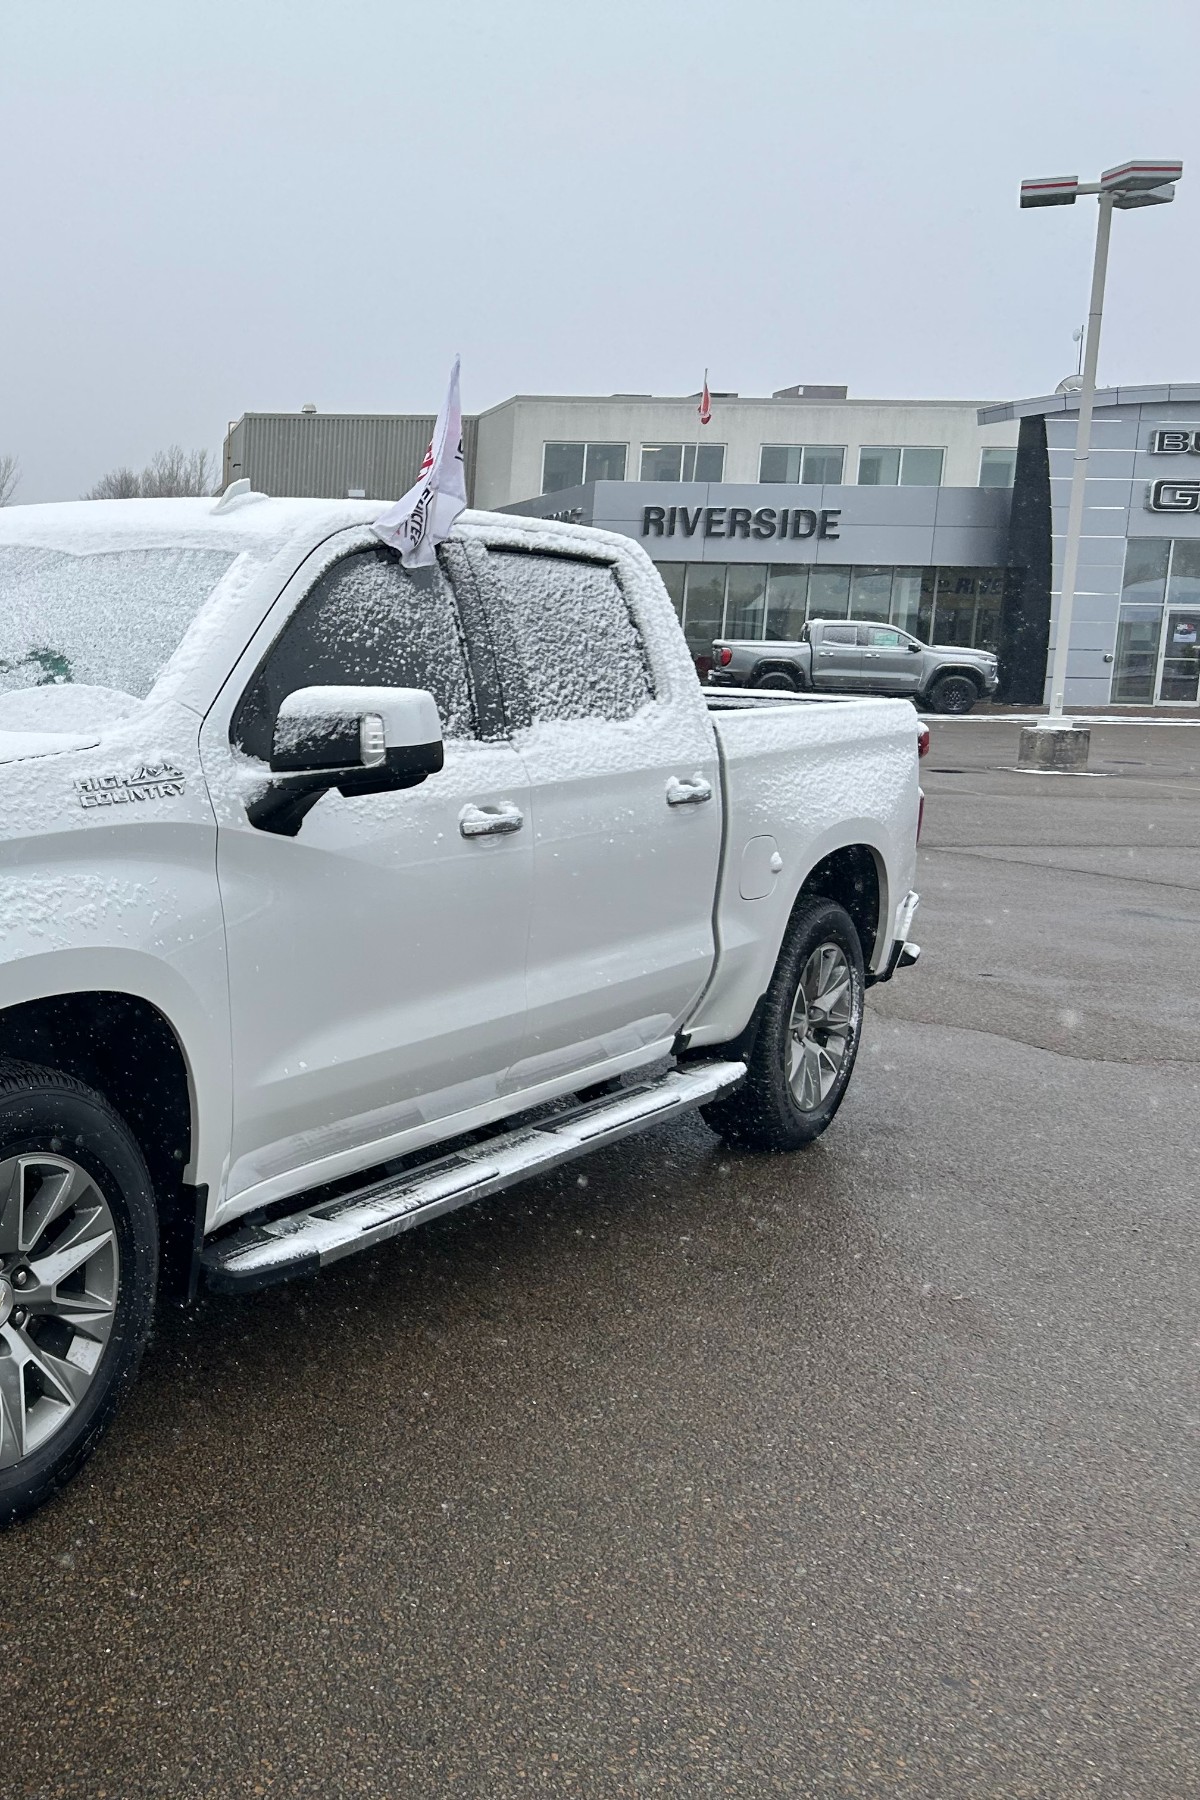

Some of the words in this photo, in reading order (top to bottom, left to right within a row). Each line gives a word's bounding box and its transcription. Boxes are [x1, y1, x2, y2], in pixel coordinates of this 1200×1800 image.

[1152, 429, 1200, 454] B
[642, 505, 842, 539] RIVERSIDE
[74, 775, 129, 793] HIGH
[80, 780, 186, 809] COUNTRY
